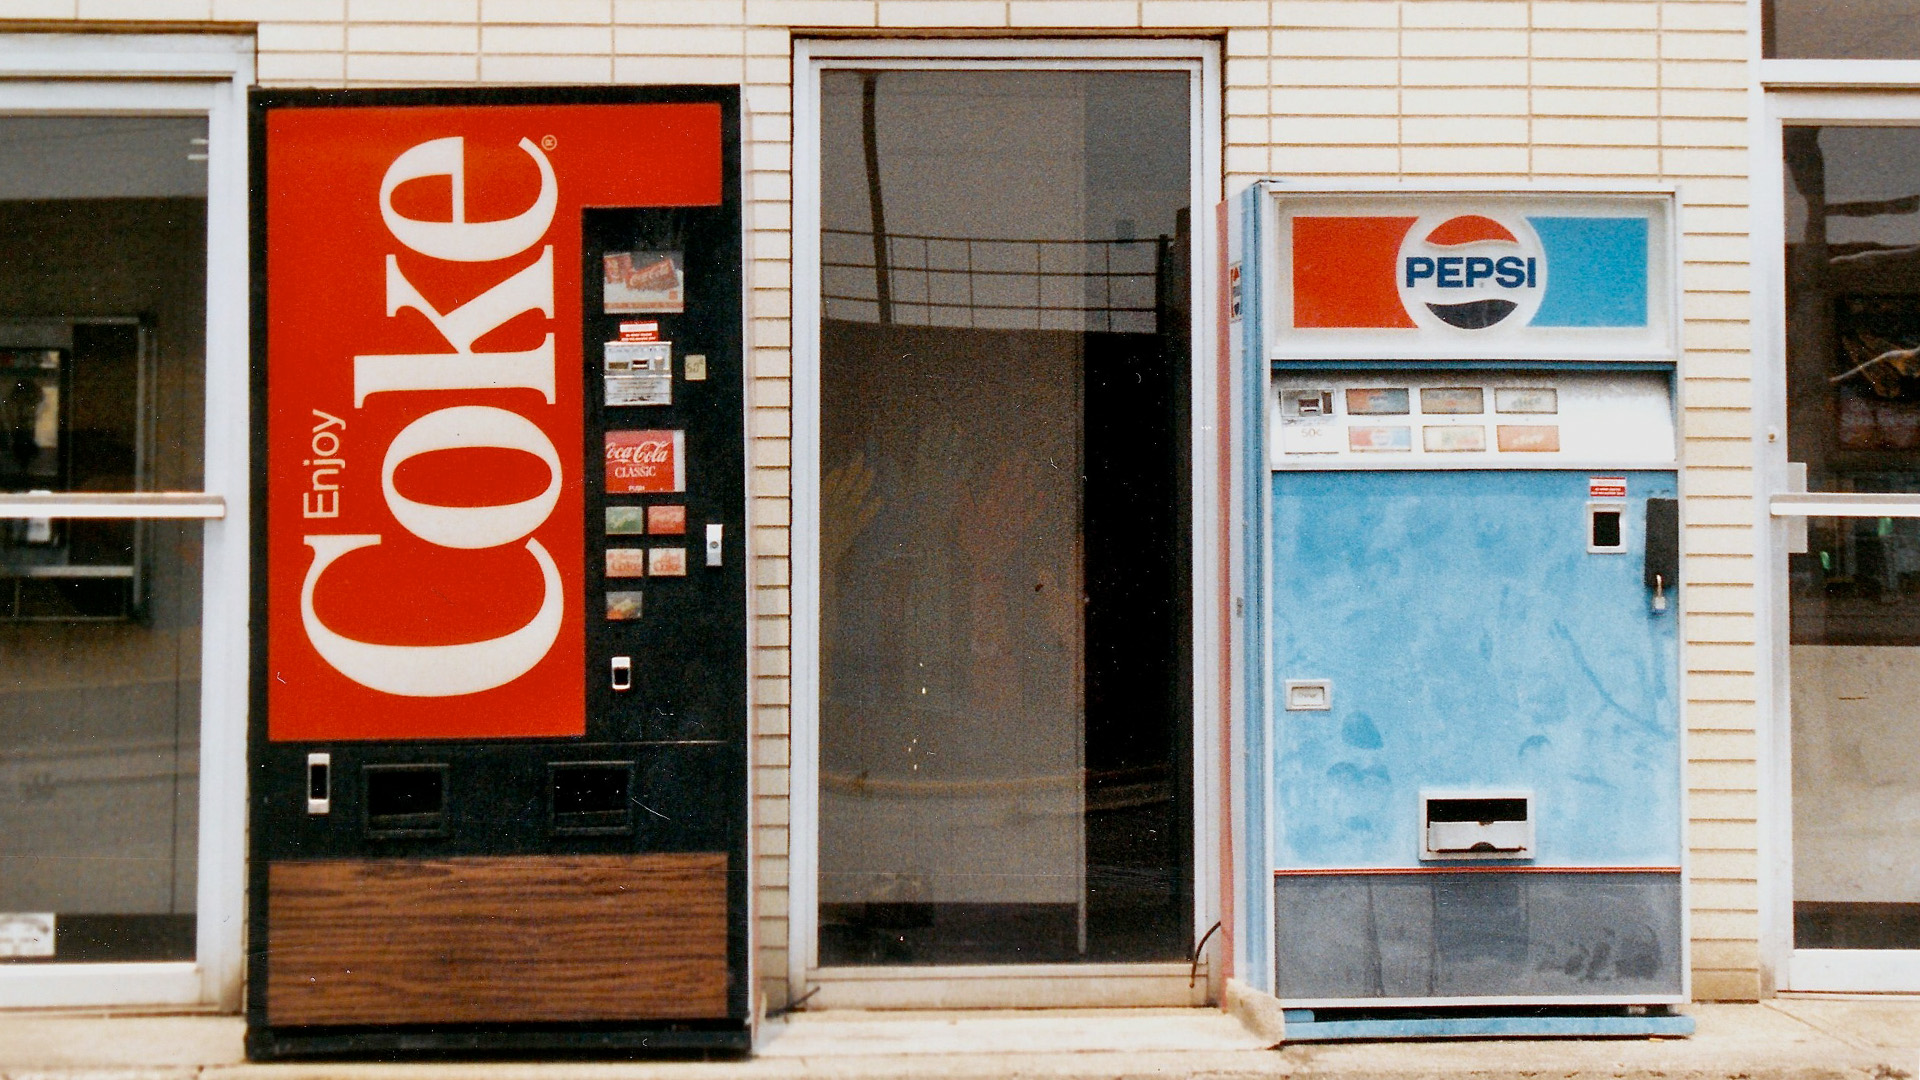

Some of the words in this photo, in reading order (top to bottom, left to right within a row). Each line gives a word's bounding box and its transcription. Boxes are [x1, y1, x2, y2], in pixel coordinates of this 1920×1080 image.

[1406, 256, 1536, 288] PEPSI
[303, 409, 346, 519] Enjoy
[614, 465, 656, 478] CLASSIC
